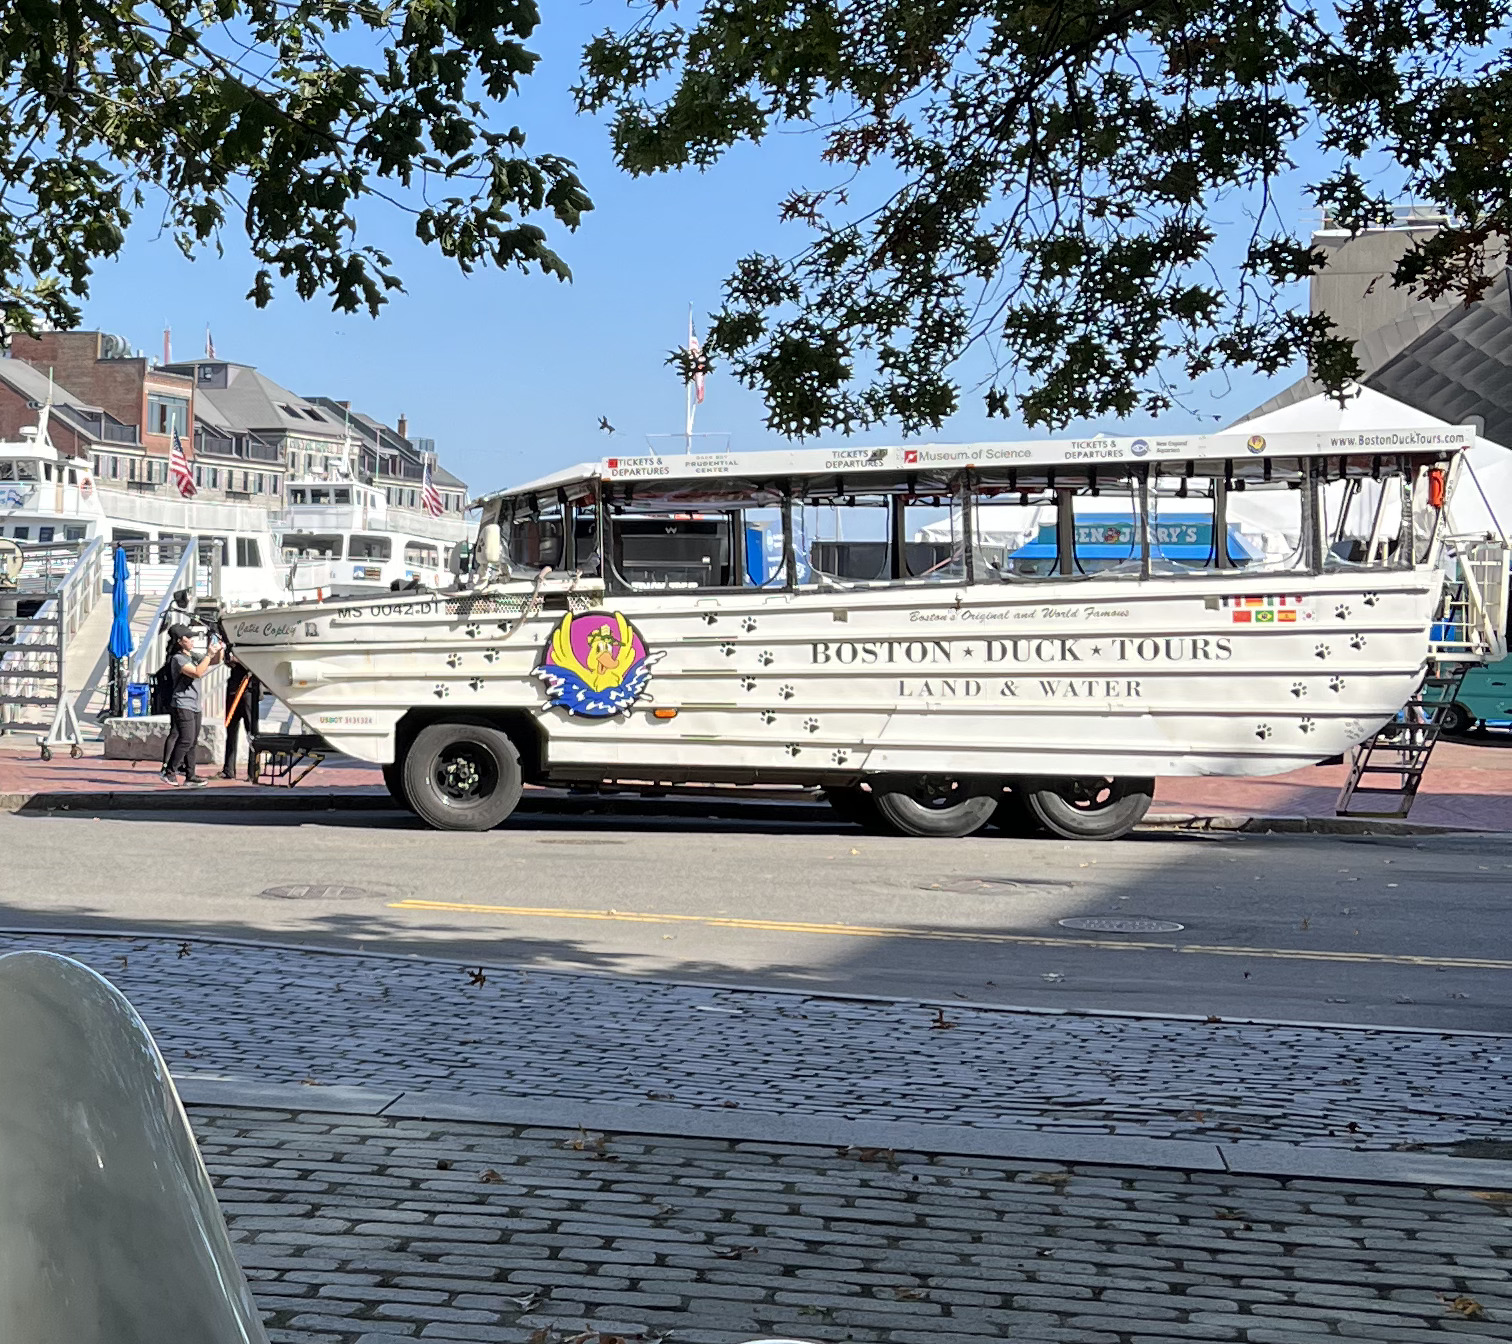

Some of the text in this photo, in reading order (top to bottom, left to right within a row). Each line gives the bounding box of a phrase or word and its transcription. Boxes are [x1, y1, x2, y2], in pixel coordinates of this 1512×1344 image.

[1071, 440, 1117, 449] TICKETS &
[1330, 432, 1465, 447] www.BostonDuckTours.com
[831, 449, 869, 459] TICKETS
[919, 447, 1032, 461] Museum of Science
[1064, 449, 1124, 460] DEPARTURES
[618, 457, 663, 467] TICKETS &
[825, 459, 884, 469] DEPARTURES
[611, 467, 670, 477] DEPARTURES
[337, 608, 363, 618] MS
[961, 609, 1009, 623] Original
[1013, 609, 1036, 619] and
[1041, 607, 1079, 618] World
[1084, 607, 1130, 618] Famous
[810, 637, 1233, 664] BOSTON DUCK TOURS
[898, 680, 1143, 698] LAND & WATER
